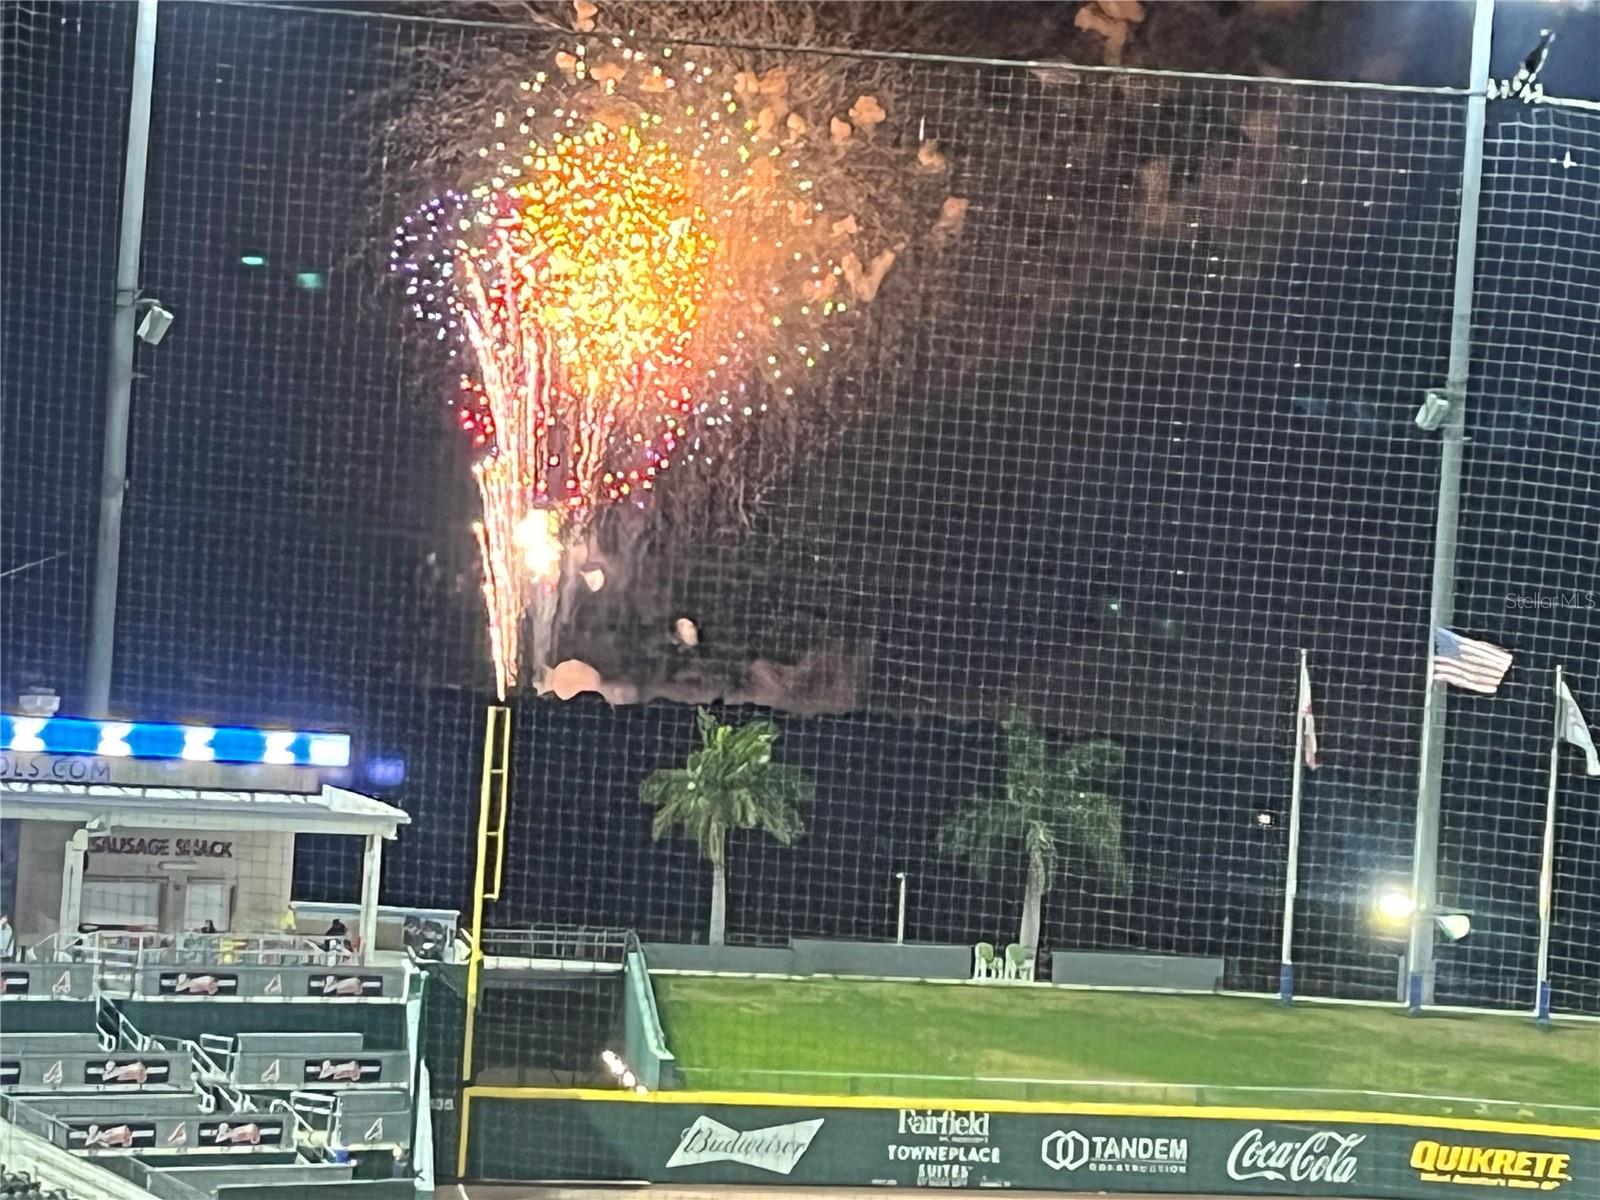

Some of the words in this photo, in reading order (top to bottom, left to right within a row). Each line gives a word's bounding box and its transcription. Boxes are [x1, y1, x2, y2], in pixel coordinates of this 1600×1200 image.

[89, 836, 170, 855] SAUSAGE
[897, 1109, 990, 1136] Fairfield
[1092, 1137, 1188, 1160] TANDEM
[1226, 1128, 1367, 1183] Coca-Cola
[1410, 1141, 1571, 1179] QUIKRETE
